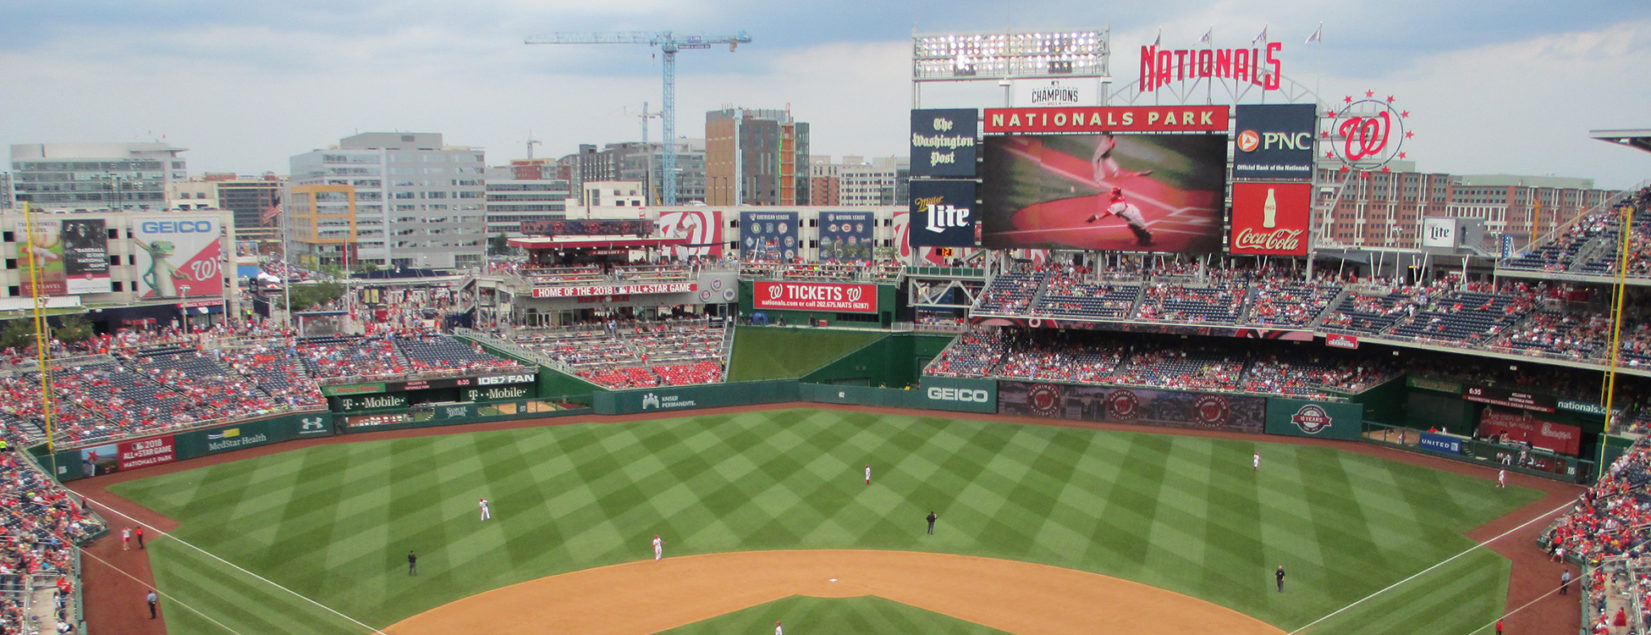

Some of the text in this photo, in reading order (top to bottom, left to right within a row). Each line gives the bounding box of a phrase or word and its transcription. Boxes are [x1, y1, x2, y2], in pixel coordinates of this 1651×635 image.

[1140, 42, 1282, 92] NATIONALS
[1031, 88, 1078, 104] CHAMPIONS
[933, 118, 954, 132] The
[992, 111, 1214, 126] NATIONALS PARK
[912, 132, 974, 150] Washington
[1262, 132, 1311, 150] PNC
[1339, 110, 1390, 160] W
[930, 151, 955, 167] Post
[914, 196, 944, 212] Miller
[926, 204, 970, 234] Lite
[142, 221, 211, 234] GEICO
[1431, 226, 1450, 240] Lite
[1236, 228, 1304, 250] Coca-Cola
[190, 257, 218, 281] W
[539, 283, 690, 297] HOME OF THE 2018 ALL STAR GAME
[787, 285, 842, 300] TICKETS
[508, 374, 534, 383] FAN
[928, 386, 988, 402] GEICO
[145, 439, 162, 447] 2018
[208, 433, 267, 451] MedStar Health
[1422, 439, 1449, 448] UNITED
[138, 448, 154, 457] STAR
[154, 445, 172, 453] GAME
[124, 458, 157, 468] NATIONALS
